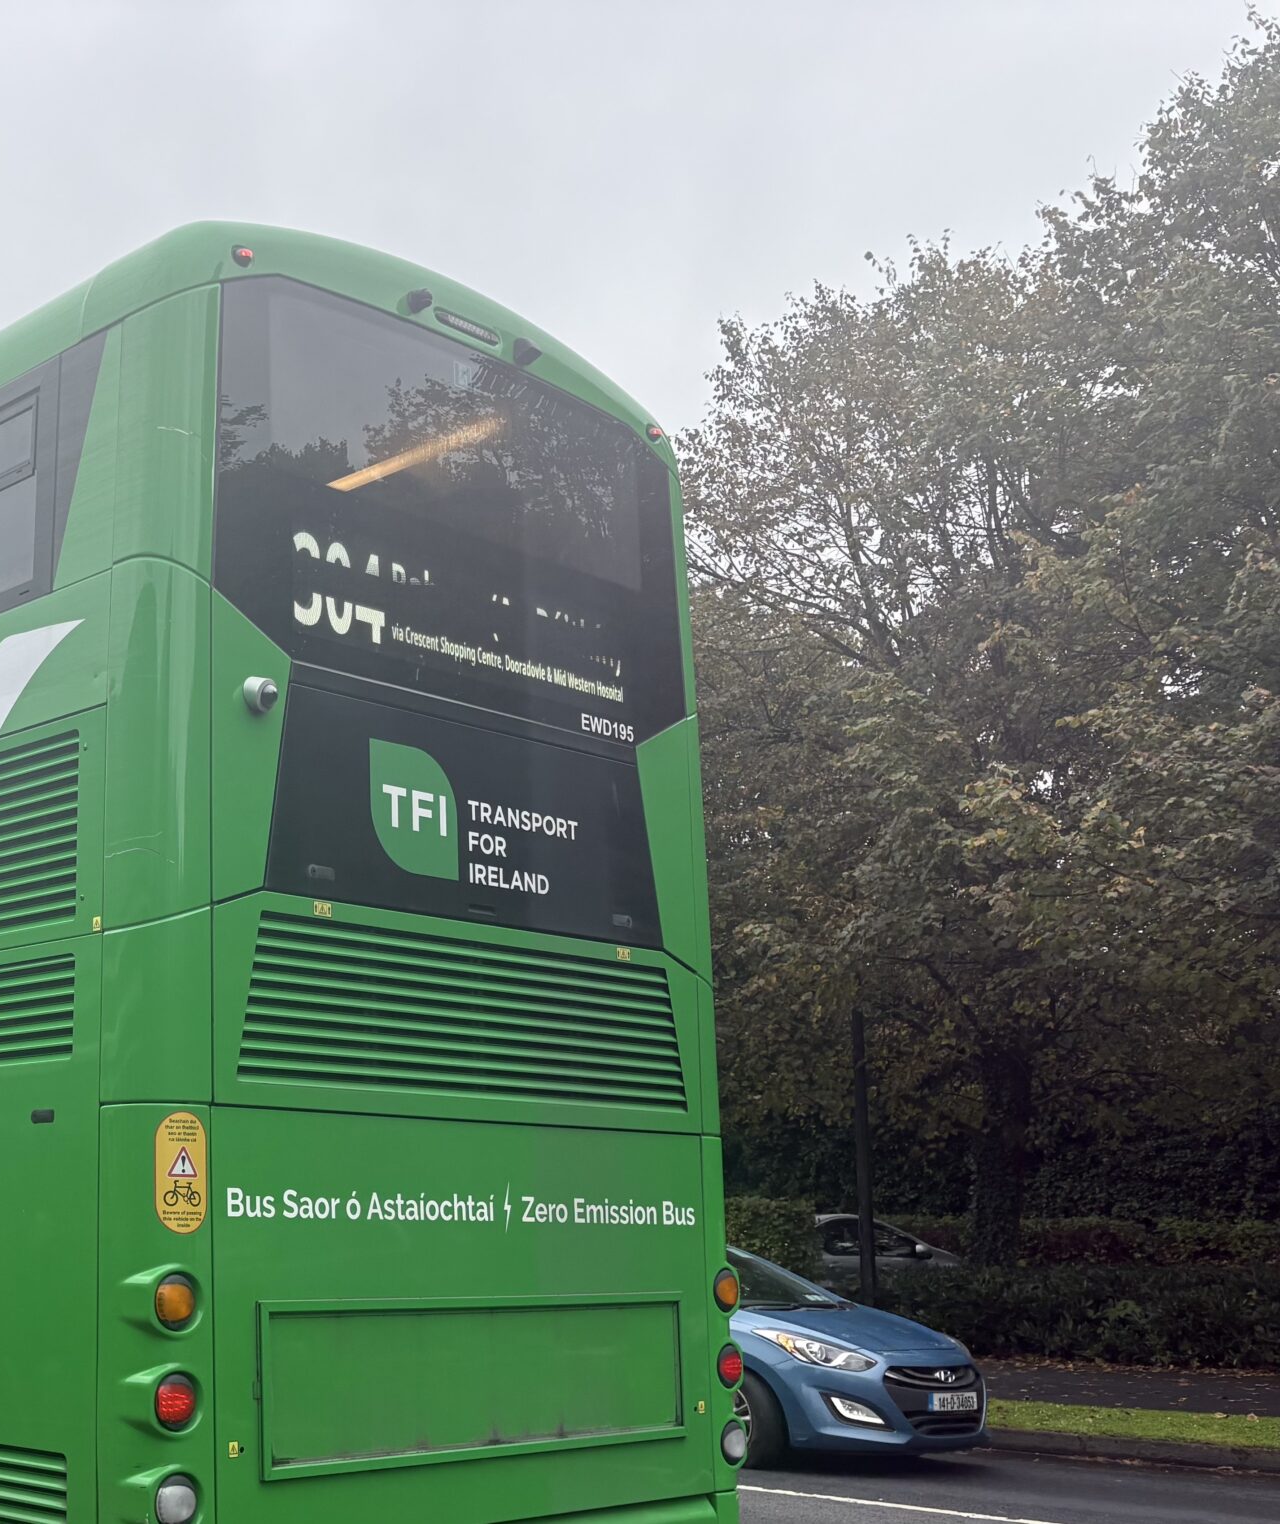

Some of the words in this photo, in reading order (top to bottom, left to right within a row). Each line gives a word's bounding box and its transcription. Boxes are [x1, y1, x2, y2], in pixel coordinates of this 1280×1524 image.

[391, 622, 404, 642] via
[405, 626, 439, 652] Crescent
[440, 636, 476, 667] Shopping
[477, 646, 504, 672] Centre,
[546, 666, 553, 683] &
[553, 667, 567, 687] Mid
[567, 671, 596, 695] Western
[581, 713, 634, 742] EWD195
[382, 783, 447, 837] TFI
[467, 799, 579, 841] TRANSPORT
[468, 831, 507, 858] FOR
[468, 862, 550, 895] IRELAND
[227, 1187, 276, 1218] Bus
[282, 1189, 340, 1220] Saor
[345, 1190, 361, 1220] ó
[366, 1191, 494, 1222] Astaíochtaí
[521, 1196, 568, 1223] Zero
[573, 1197, 657, 1225] Emission
[662, 1200, 696, 1226] Bus
